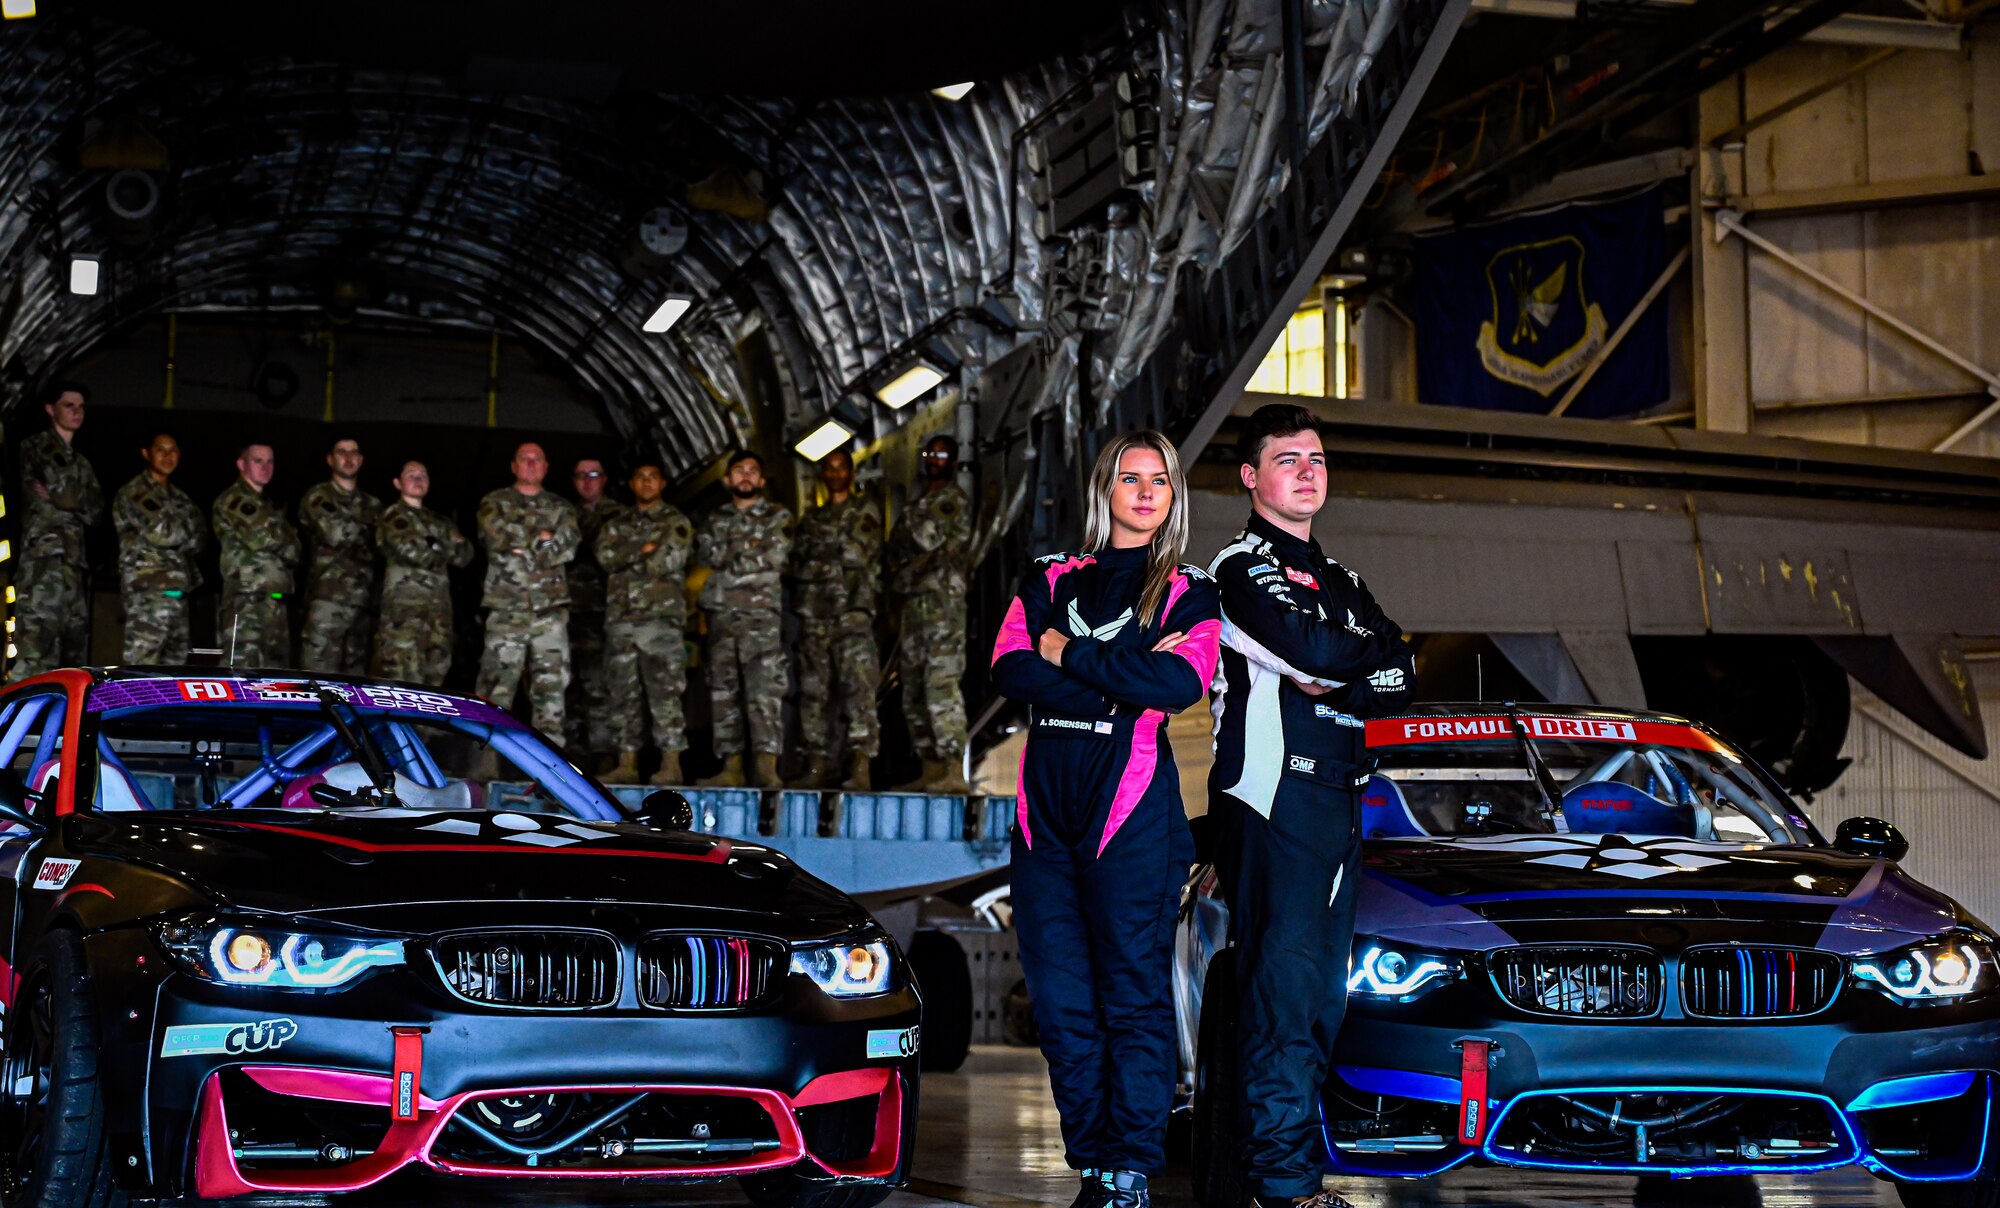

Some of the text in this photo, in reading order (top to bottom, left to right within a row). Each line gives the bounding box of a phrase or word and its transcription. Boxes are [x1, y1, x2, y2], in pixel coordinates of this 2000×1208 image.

[184, 682, 228, 699] FD
[362, 687, 454, 707] PRO
[373, 698, 461, 716] SPEC
[1040, 718, 1092, 730] A. SORENSEN
[1538, 718, 1630, 739] DRIFT
[1290, 758, 1315, 771] OMP
[38, 862, 69, 881] COMP
[225, 1020, 297, 1053] CUP
